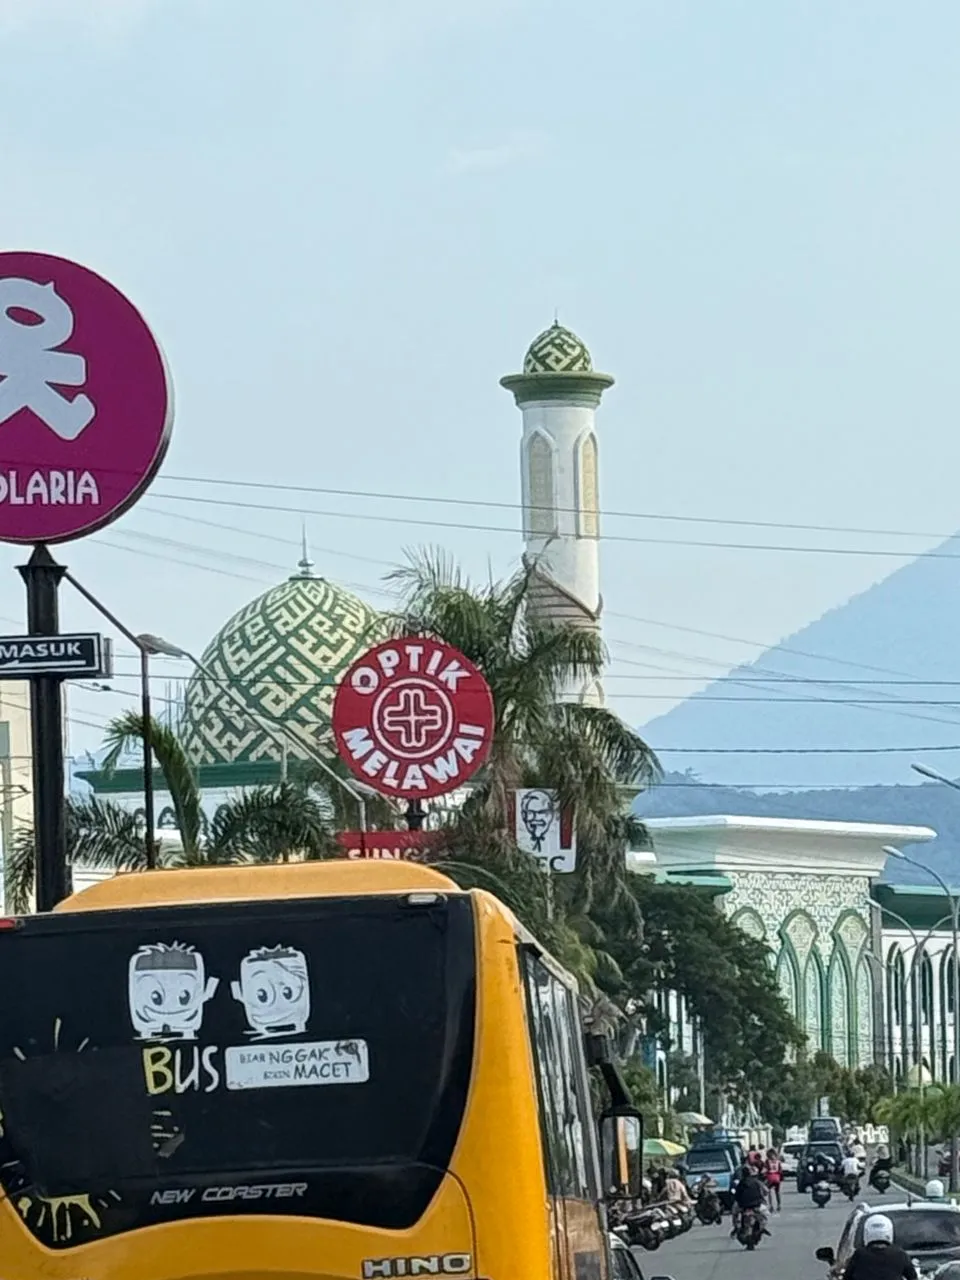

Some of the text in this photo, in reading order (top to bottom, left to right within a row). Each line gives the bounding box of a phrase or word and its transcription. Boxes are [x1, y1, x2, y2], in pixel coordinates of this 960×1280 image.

[0, 642, 81, 658] MASUK
[351, 645, 471, 694] OPTIK
[342, 723, 485, 789] MELAWAI
[269, 1047, 330, 1064] NGGAK
[143, 1046, 219, 1096] BUS
[293, 1062, 352, 1080] MACET
[150, 1182, 308, 1205] NEW COASTER
[363, 1253, 471, 1278] HINO
